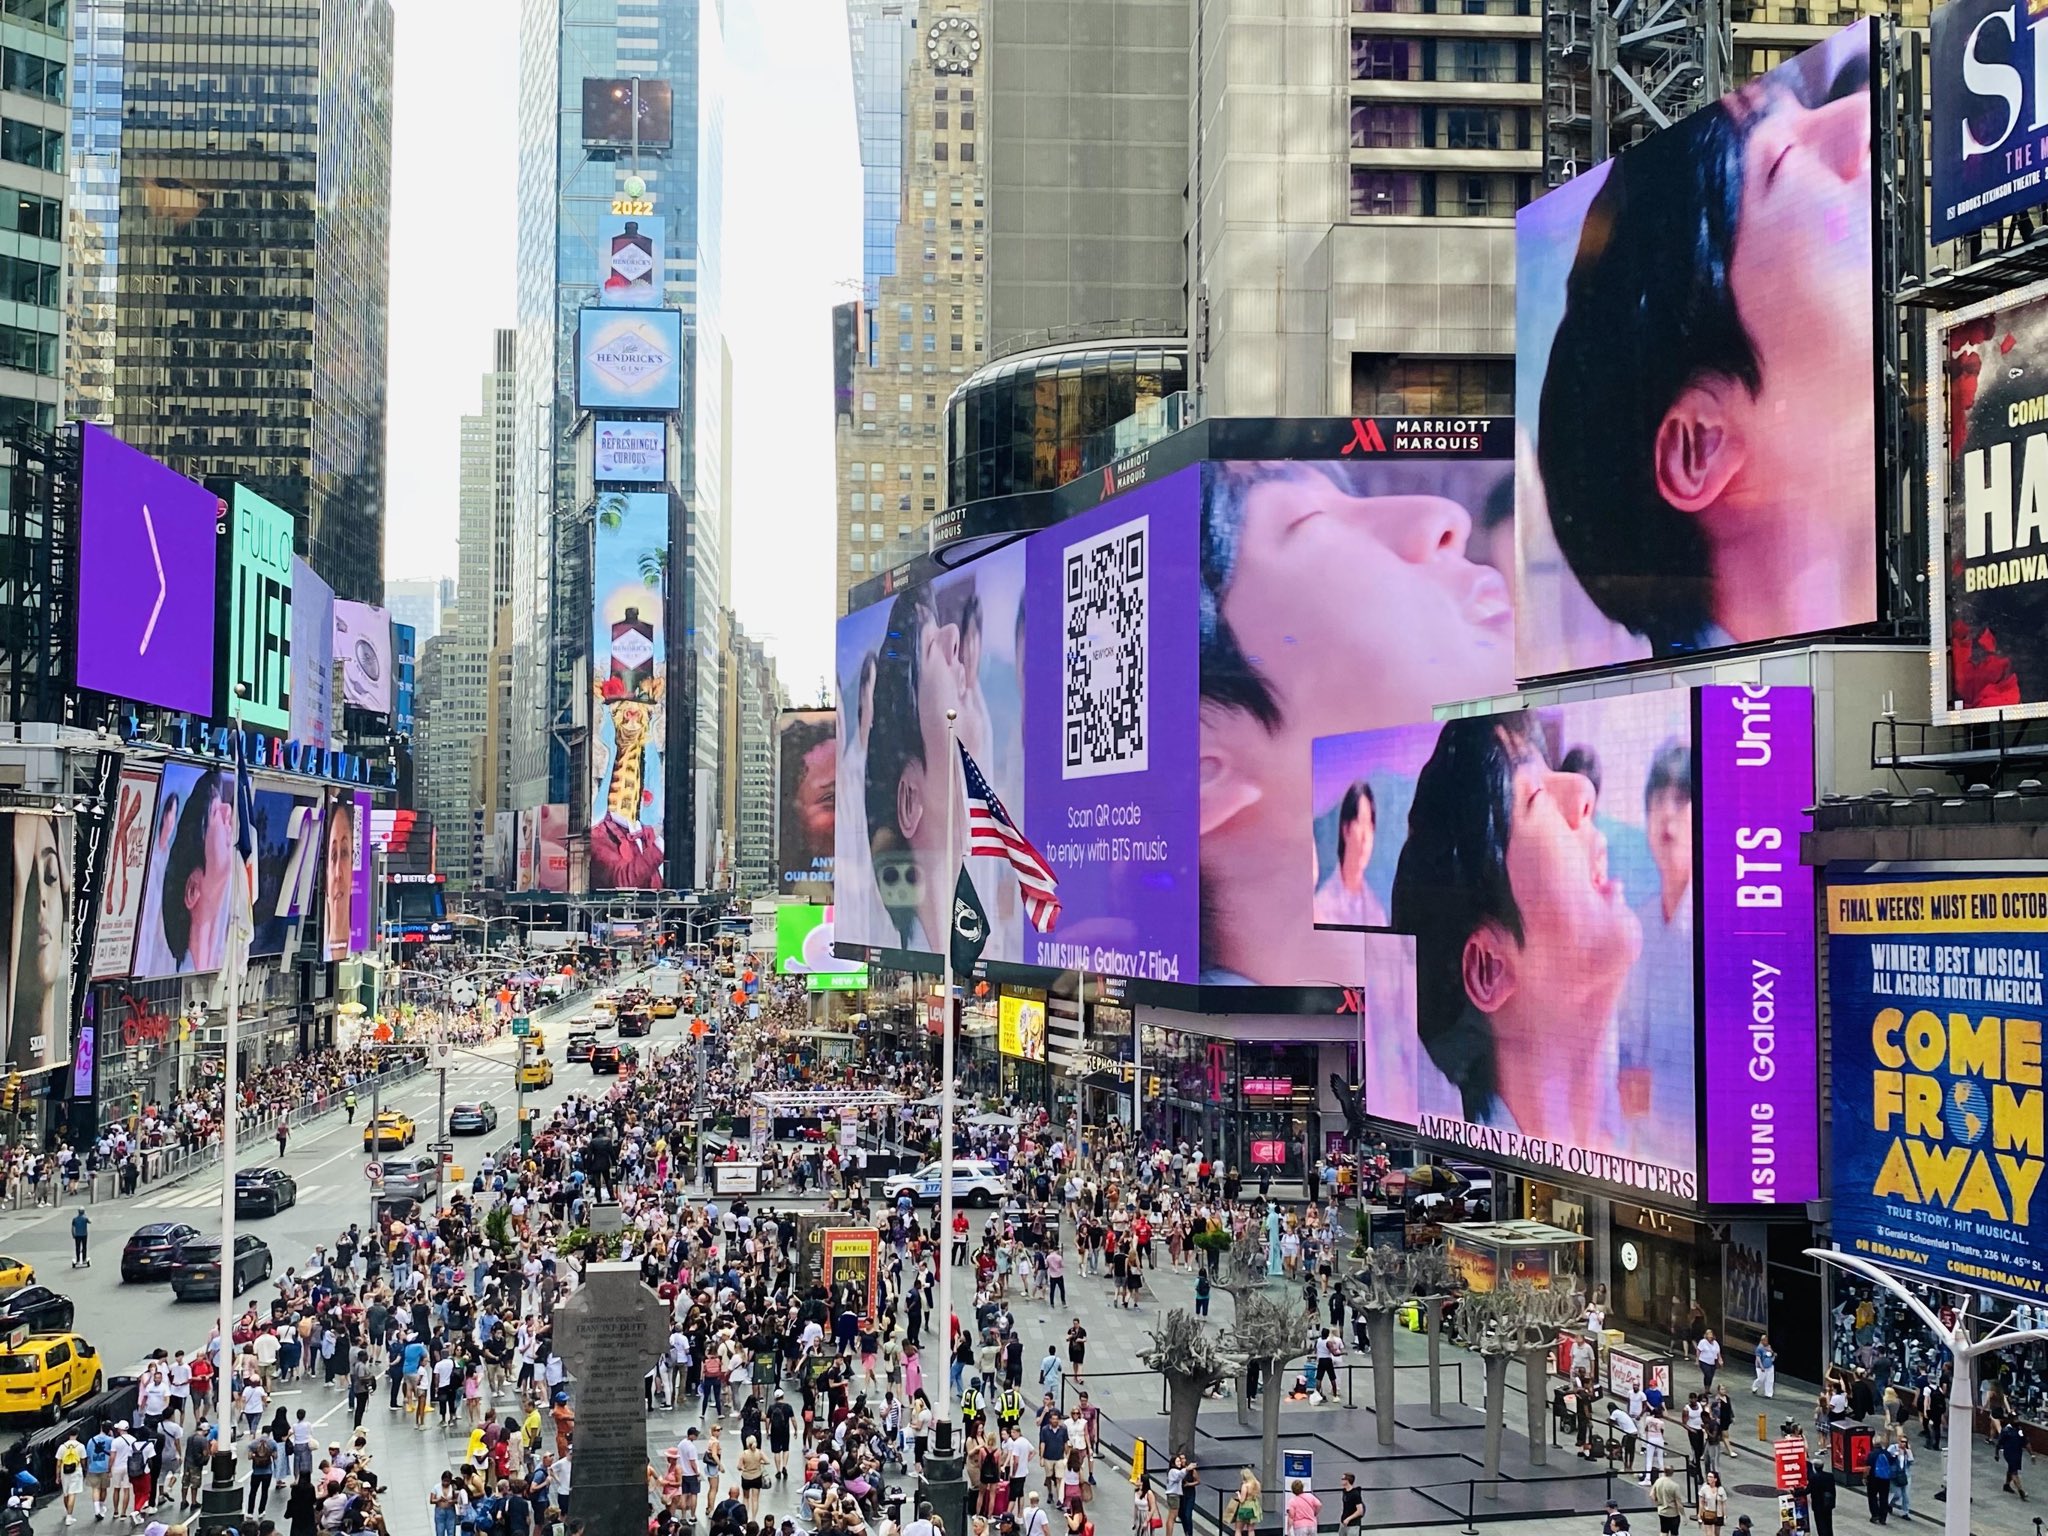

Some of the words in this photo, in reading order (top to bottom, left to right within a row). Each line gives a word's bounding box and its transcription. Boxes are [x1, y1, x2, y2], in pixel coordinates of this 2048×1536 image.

[2005, 143, 2033, 174] THE
[1982, 181, 2013, 206] ATKINSON
[2012, 170, 2041, 193] THEATRE
[611, 201, 653, 215] 2022
[597, 353, 663, 364] HENDRICK'S
[1396, 420, 1490, 433] MARRIOTT
[601, 437, 659, 452] REFRESHINGLY
[613, 452, 646, 465] CURIOUS
[1396, 437, 1479, 450] MARQUIS
[1117, 450, 1150, 474] MARRIOTT
[1117, 466, 1146, 490] MARQUIS
[242, 509, 276, 567] FULL
[280, 531, 294, 574] O
[237, 564, 292, 712] LIFE
[256, 733, 373, 784] BROADWAY
[1068, 806, 1093, 829] Scan
[1095, 804, 1110, 826] QR
[1112, 802, 1142, 825] code
[1047, 841, 1057, 862] to
[1058, 838, 1086, 869] enjoy
[1088, 836, 1110, 862] with
[1112, 838, 1131, 861] BTS
[1132, 835, 1168, 861] music
[1736, 826, 1783, 909] BTS
[784, 871, 809, 883] OUR
[1840, 898, 1873, 922] FINAL
[1876, 896, 1925, 922] WEEKS!
[1931, 894, 1967, 920] MUST
[1971, 893, 1998, 919] END
[1037, 942, 1090, 972] SAMSUNG
[1094, 947, 1138, 978] Galaxy
[1138, 951, 1147, 978] Z
[1149, 949, 1180, 982] Flip4
[1871, 943, 1931, 973] WINNER!
[1935, 946, 1970, 975] BEST
[1974, 947, 2043, 979] MUSICAL
[1872, 972, 1893, 994] ALL
[1895, 973, 1940, 998] ACROSS
[1943, 976, 1982, 1001] NORTH
[1985, 979, 2043, 1006] AMERICA
[930, 1005, 945, 1023] Lev
[1748, 959, 1781, 1082] Galaxy
[1872, 1007, 2042, 1086] COME
[1088, 1055, 1124, 1077] SEPHORA
[1419, 1114, 1503, 1155] AMERICAN
[1508, 1132, 1564, 1168] EAGLE
[1569, 1147, 1695, 1200] OUTFITTERS
[1873, 1136, 2045, 1226] AWAY
[1886, 1205, 1913, 1222] TRUE
[1955, 1218, 1972, 1232] HIT
[1975, 1222, 2029, 1246] MUSICAL.
[1856, 1239, 1869, 1250] ON
[1871, 1241, 1930, 1266] BROADWAY
[1885, 1228, 1908, 1243] Gerald
[1909, 1233, 1950, 1250] Schoenfeld
[1951, 1241, 1983, 1260] Theatre,
[1984, 1249, 1999, 1262] 236
[2001, 1252, 2012, 1265] W.
[2032, 1260, 2044, 1272] St.
